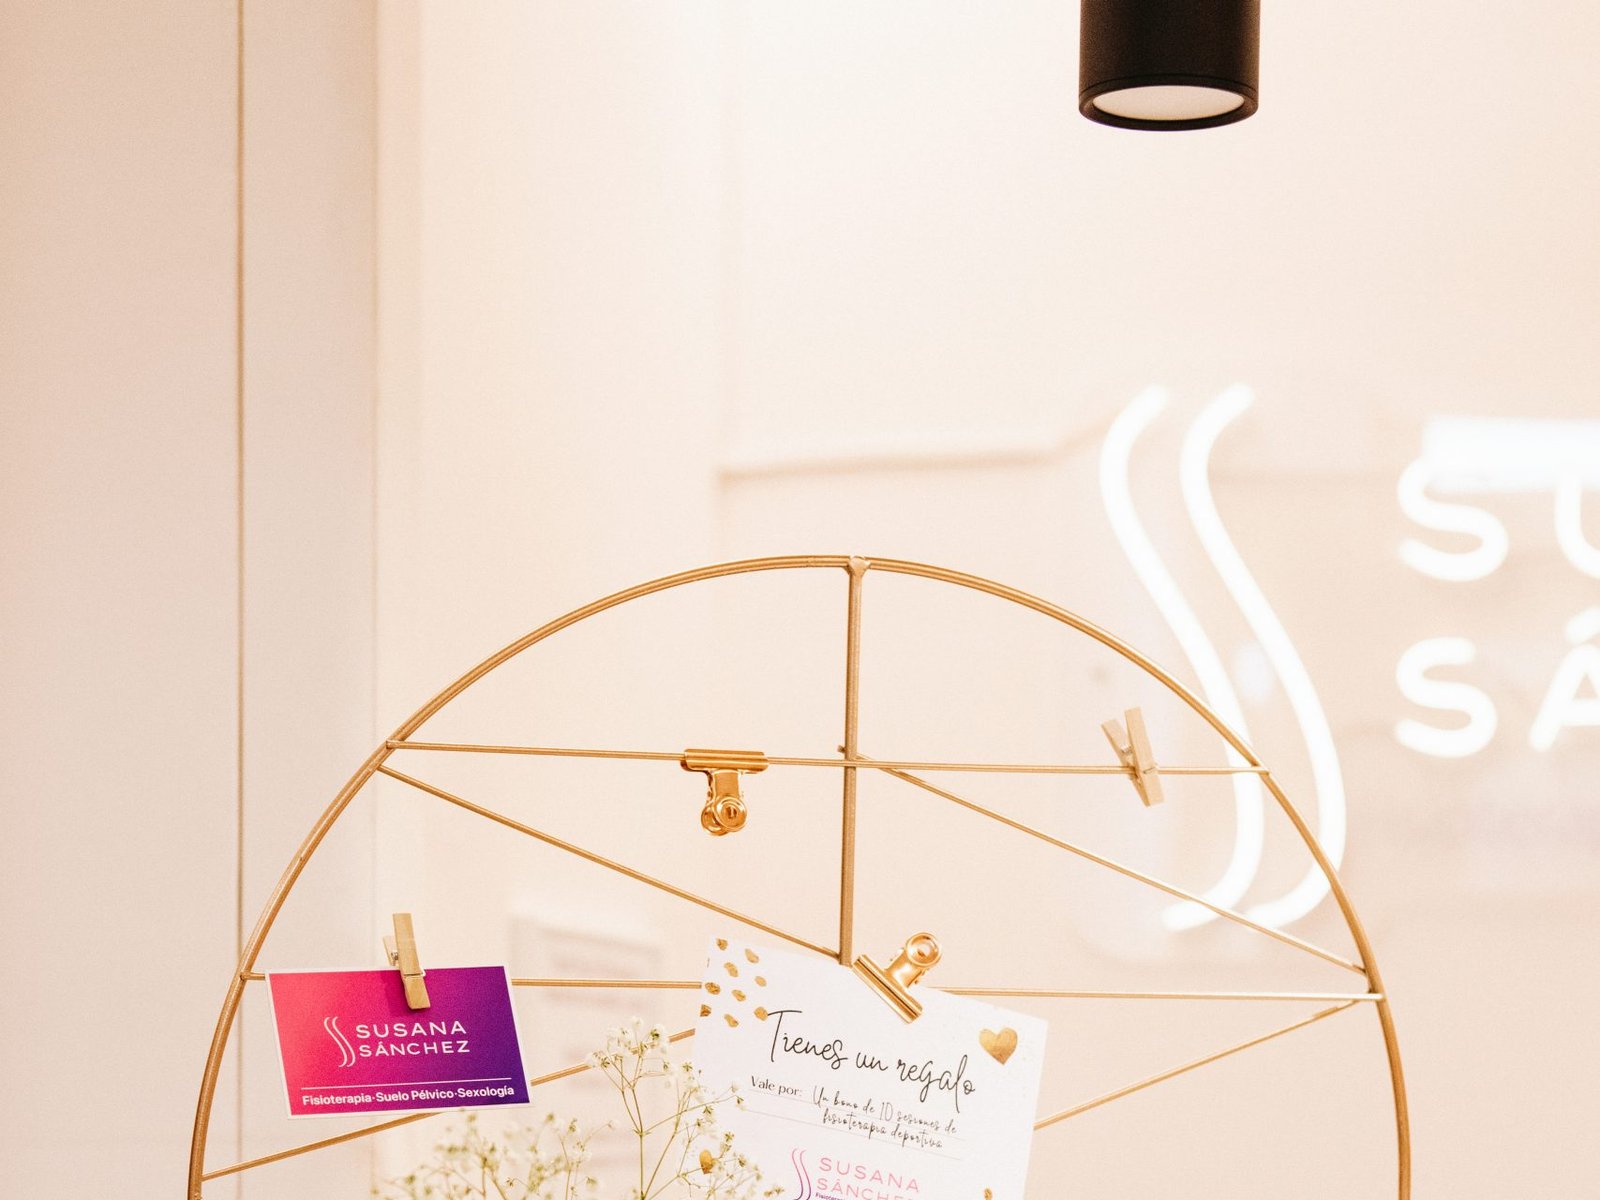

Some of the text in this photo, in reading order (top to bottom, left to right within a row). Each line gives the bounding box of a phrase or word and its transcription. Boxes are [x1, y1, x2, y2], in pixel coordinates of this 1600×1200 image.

[355, 1020, 467, 1039] SUSANA
[358, 1040, 471, 1058] SÁNCHEZ
[767, 1010, 976, 1114] Tienes un regalo
[751, 1075, 957, 1134] Vale por: Un bono de 10 sesiones de
[822, 1108, 943, 1148] fisioterapia deportiva
[819, 1157, 920, 1193] SUSANA
